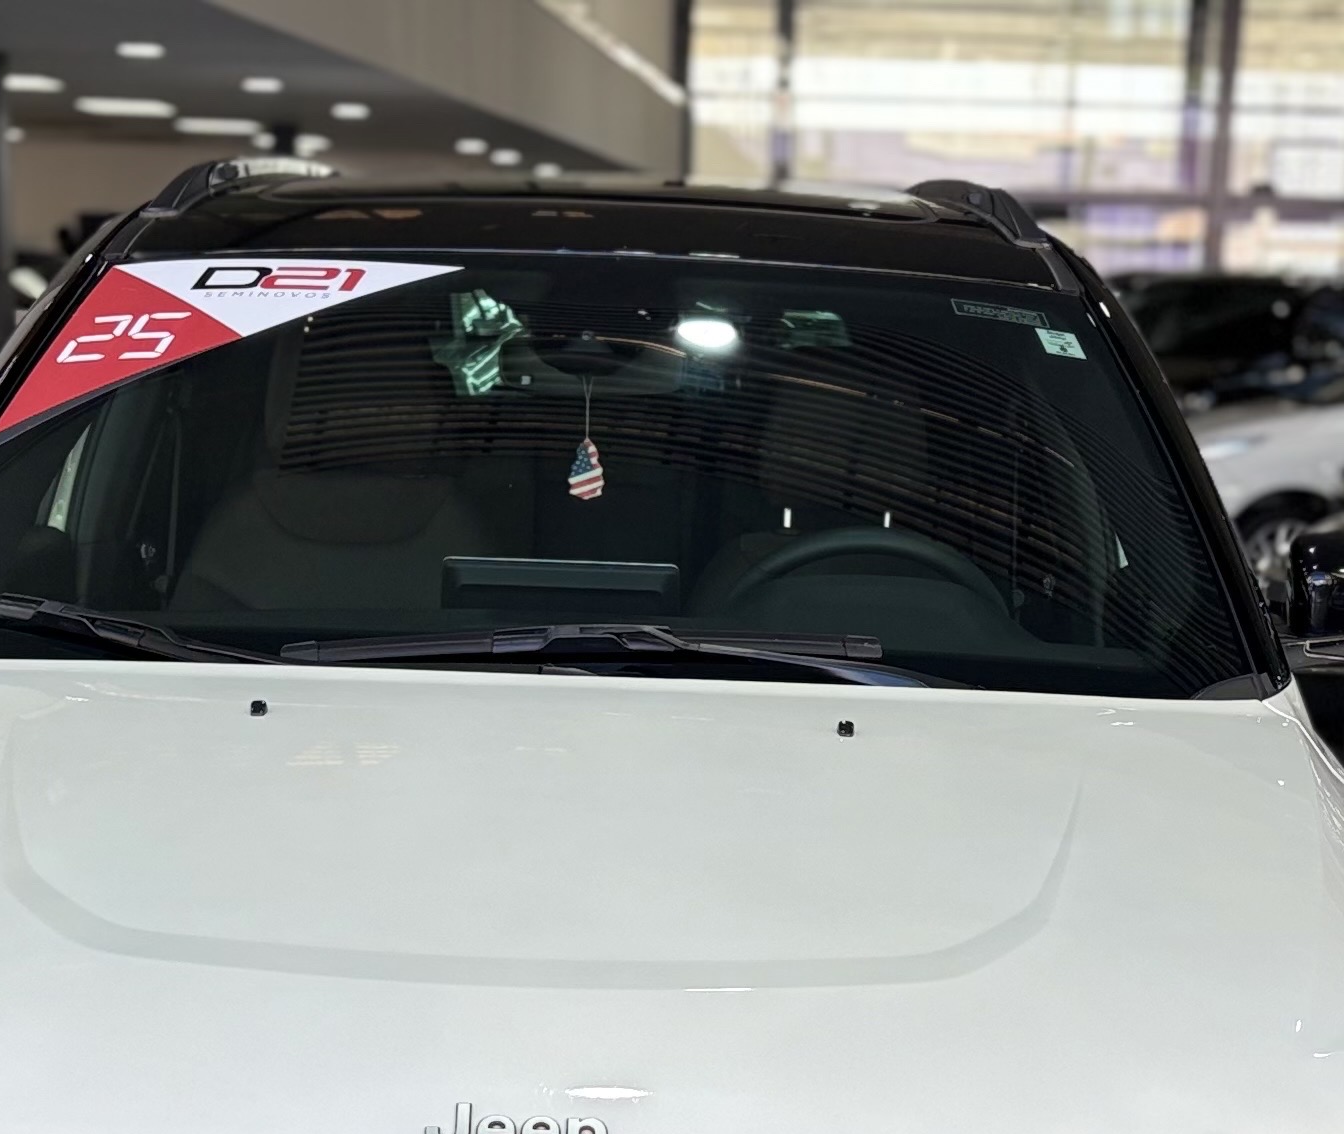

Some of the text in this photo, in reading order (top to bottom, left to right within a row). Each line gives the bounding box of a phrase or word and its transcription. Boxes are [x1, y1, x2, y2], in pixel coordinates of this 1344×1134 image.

[190, 266, 367, 292] D21
[204, 291, 331, 300] SEMINOVOS
[56, 311, 192, 364] 25
